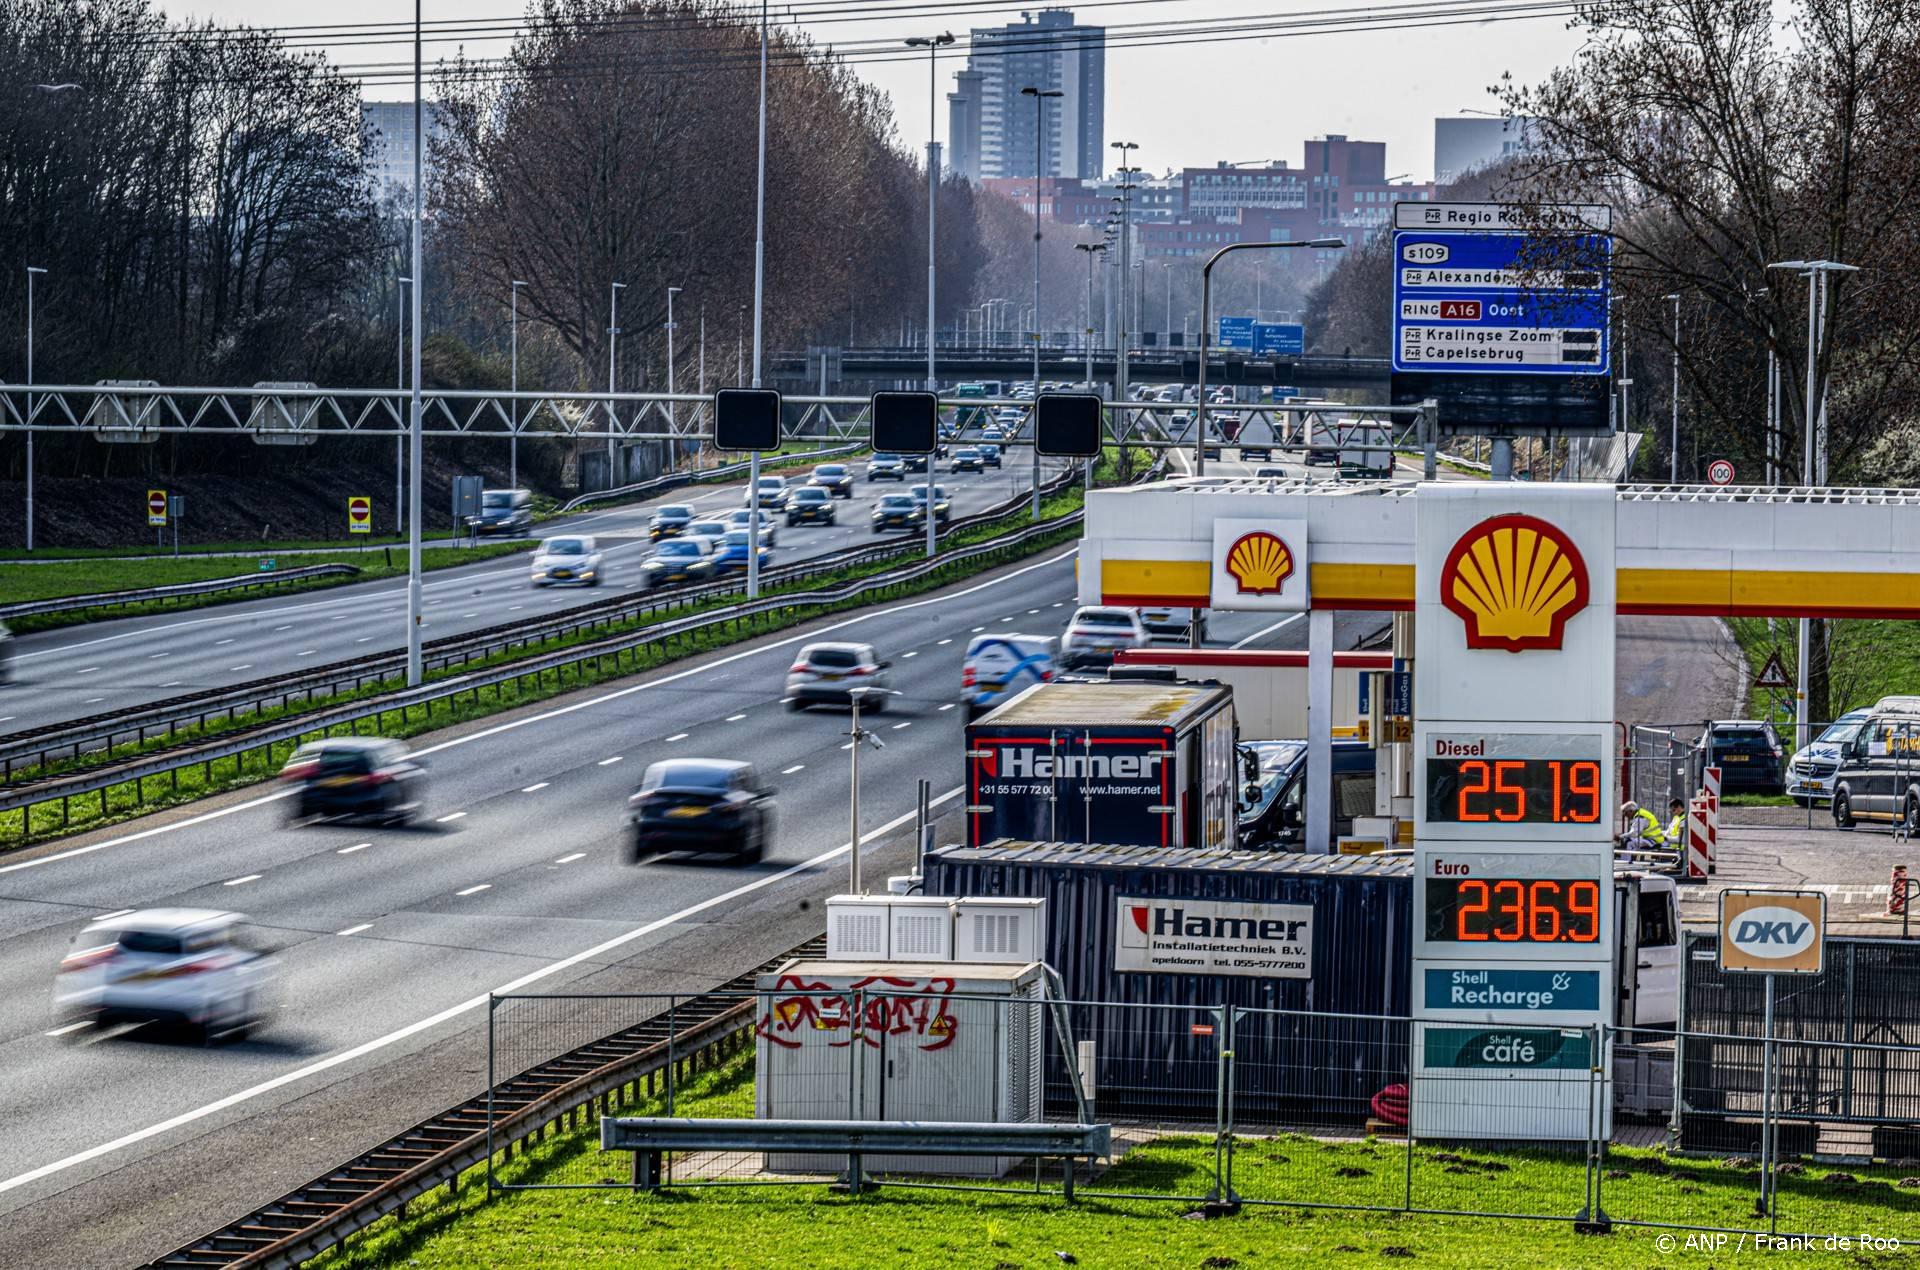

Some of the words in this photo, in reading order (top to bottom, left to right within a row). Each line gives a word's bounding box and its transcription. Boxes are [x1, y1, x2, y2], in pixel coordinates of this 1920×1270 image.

[1447, 211, 1492, 225] Regio
[1408, 248, 1445, 259] s109
[1426, 271, 1508, 283] Alexander
[1403, 304, 1439, 315] RING
[1446, 304, 1475, 316] A16
[1489, 304, 1524, 316] Oost
[1426, 329, 1502, 344] Kralingse
[1509, 330, 1551, 342] Zoom
[1426, 347, 1524, 362] Capelsebrug
[1713, 468, 1730, 478] 100
[1361, 726, 1369, 737] 1
[1396, 726, 1409, 738] 12
[1436, 740, 1484, 757] Diesel
[1001, 748, 1162, 778] Hamer
[978, 785, 996, 794] +31
[998, 785, 1010, 794] 55
[1011, 785, 1028, 794] 577
[1030, 785, 1041, 794] 72
[1080, 784, 1161, 795] www.hamer.net
[1458, 761, 1600, 822] 251.9
[1434, 860, 1470, 876] Euro
[1458, 880, 1599, 942] 236.9
[1153, 908, 1307, 941] Hamer
[1734, 920, 1810, 944] DKV
[1152, 941, 1276, 954] Installatietechniek
[1282, 946, 1307, 956] B.V.
[1152, 956, 1204, 966] apeldoorn
[1214, 958, 1231, 966] tel.
[1452, 971, 1488, 985] Shell
[1451, 986, 1554, 1010] Recharge
[1489, 1035, 1512, 1045] Shell
[1482, 1040, 1536, 1064] café
